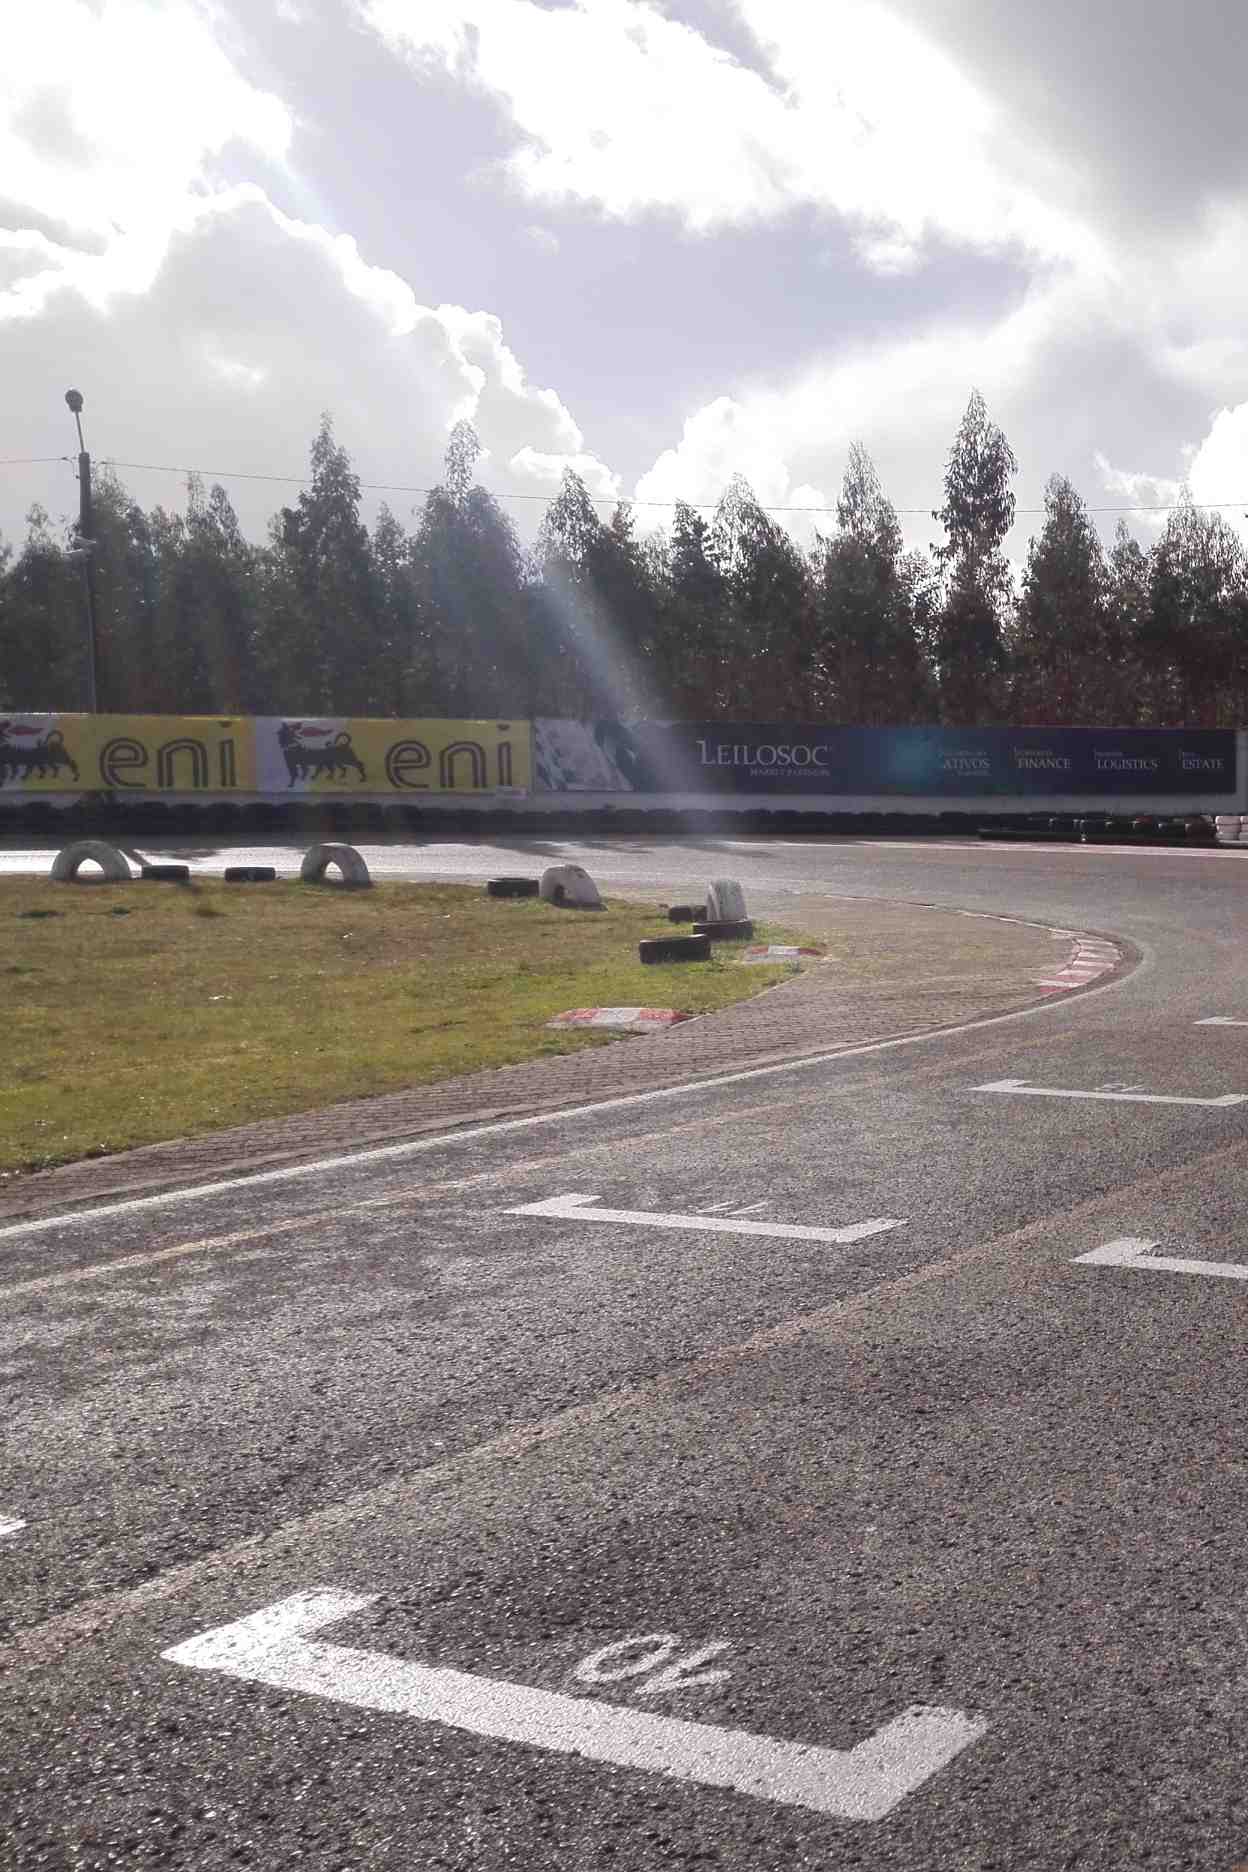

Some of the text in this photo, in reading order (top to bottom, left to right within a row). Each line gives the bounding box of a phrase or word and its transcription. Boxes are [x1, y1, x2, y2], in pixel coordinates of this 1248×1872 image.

[100, 720, 238, 788] eni
[384, 723, 511, 789] eni
[696, 739, 830, 766] LEILOSOC
[1016, 758, 1073, 770] FINANCE
[1096, 758, 1160, 770] LOGISTICS
